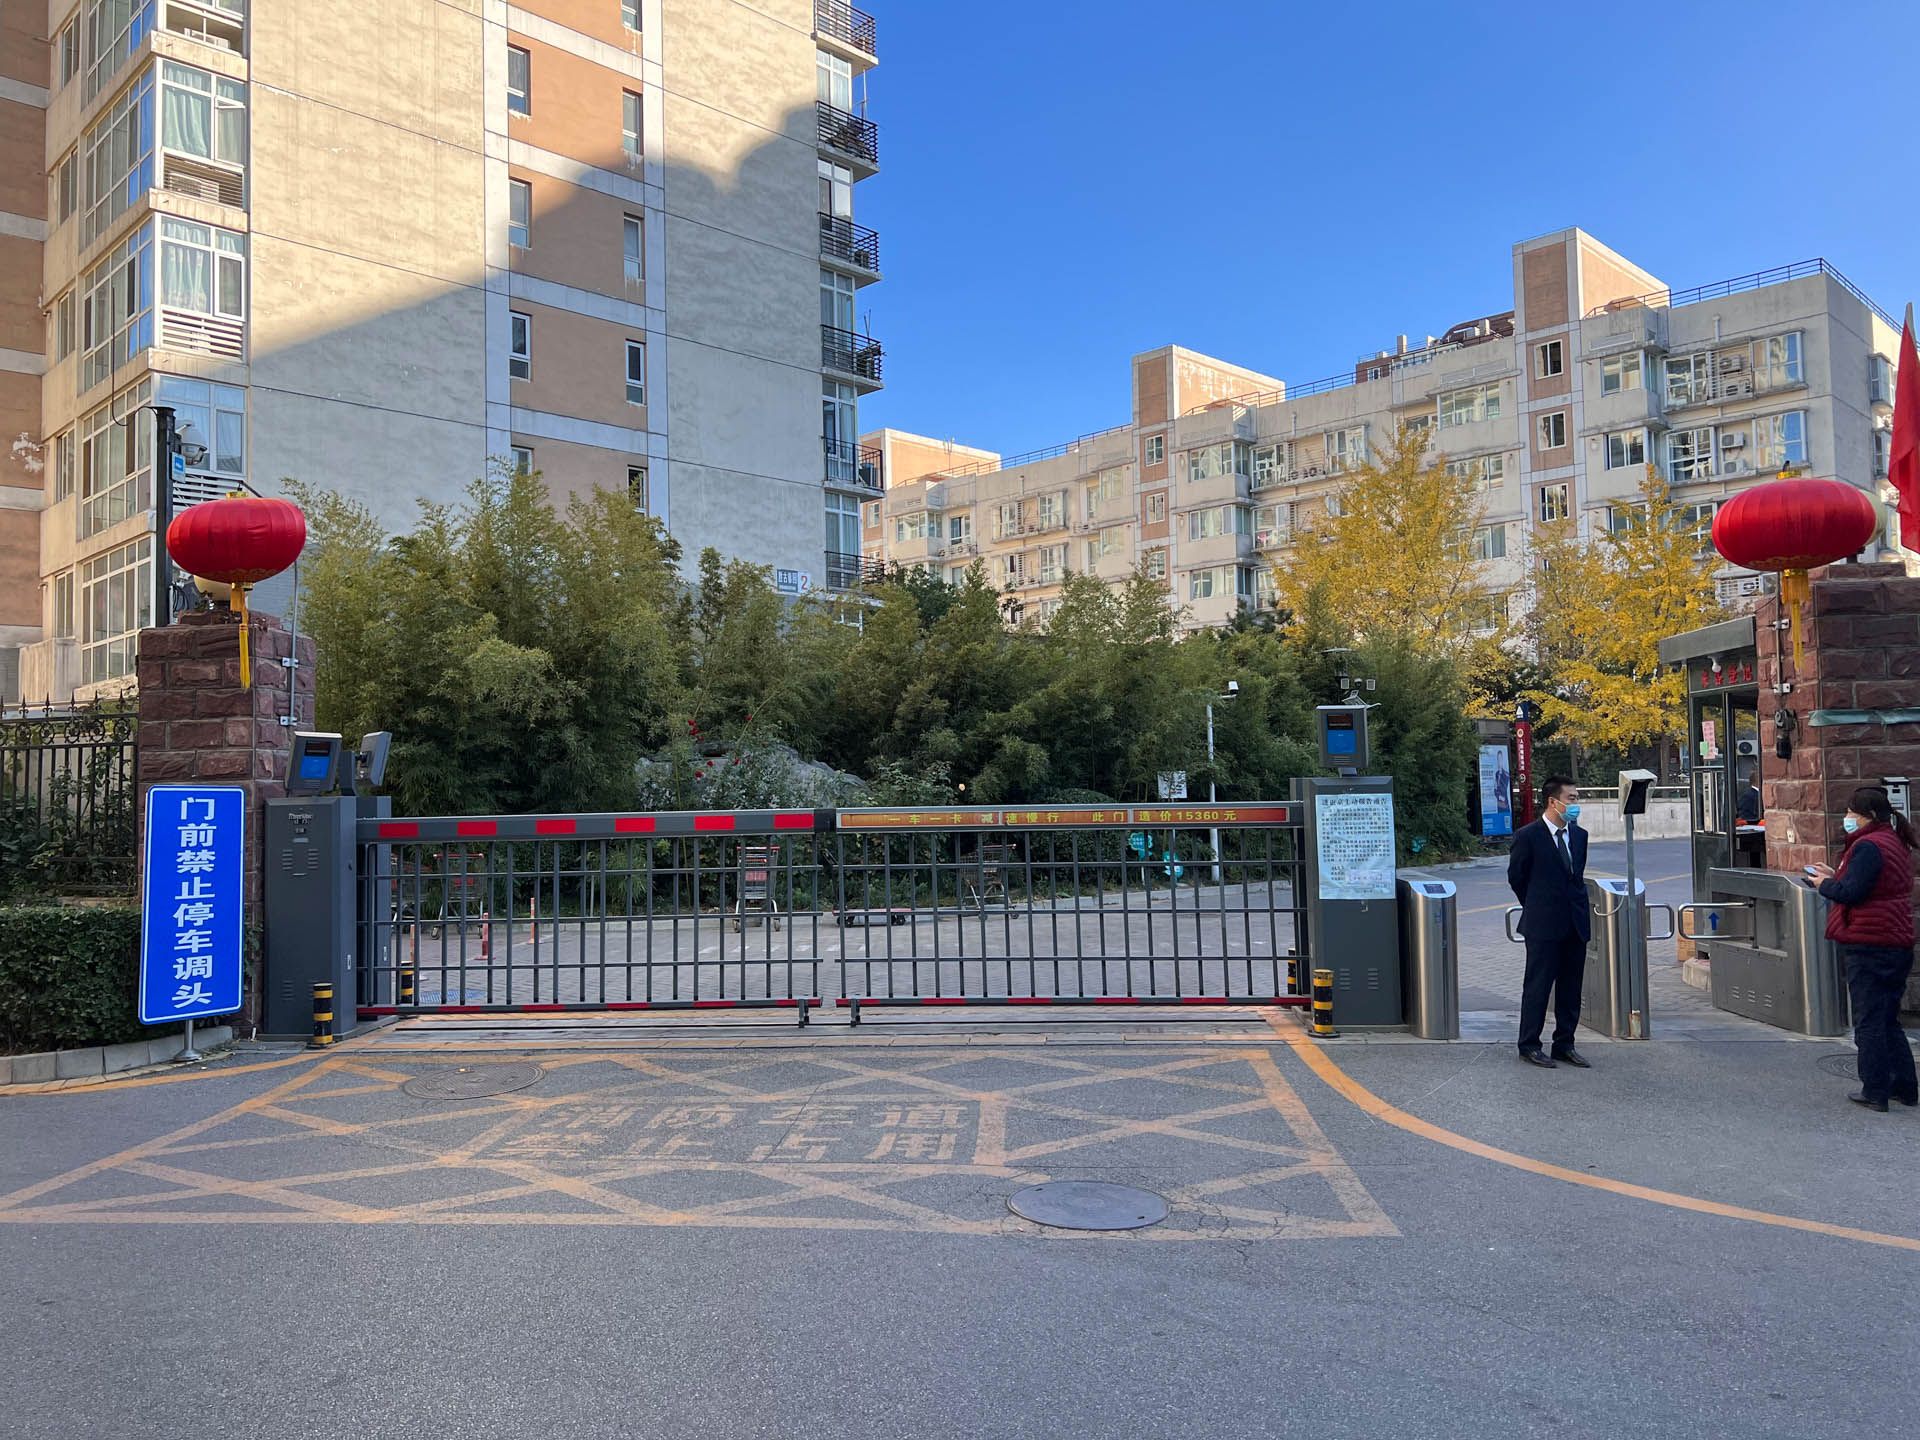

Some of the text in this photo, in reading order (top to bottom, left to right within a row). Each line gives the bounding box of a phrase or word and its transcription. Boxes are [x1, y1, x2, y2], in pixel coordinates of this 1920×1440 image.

[888, 814, 962, 825] 一车一卡
[172, 797, 216, 1007] 门前禁止停车调头
[542, 1103, 968, 1129] 消防车道
[496, 1133, 957, 1162] 禁止占用
